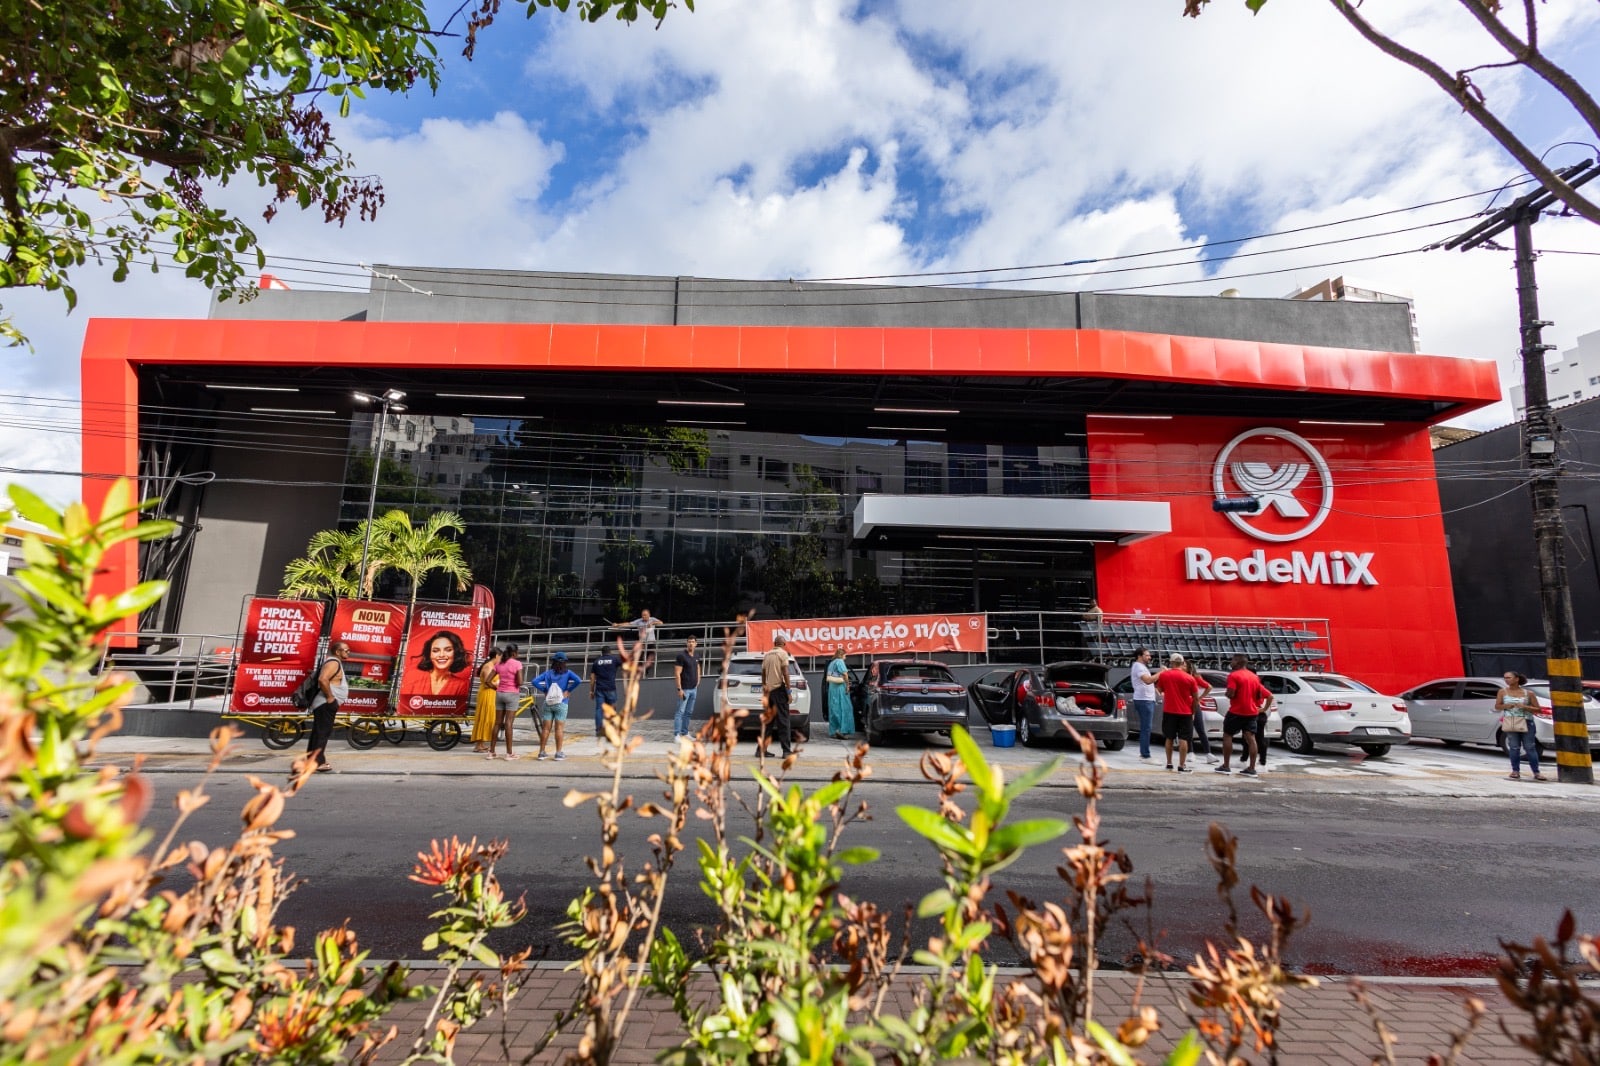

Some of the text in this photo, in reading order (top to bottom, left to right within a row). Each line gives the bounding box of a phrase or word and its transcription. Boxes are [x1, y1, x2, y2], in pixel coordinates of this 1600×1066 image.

[1184, 546, 1379, 585] RedeMiX
[261, 607, 305, 621] PIPOCA,
[358, 611, 386, 623] NOVA
[421, 611, 471, 621] CHAME-CHAME
[258, 618, 315, 633] CHICLETE,
[352, 623, 386, 634] REDEMIX
[772, 621, 909, 643] INAUGURAÇÃO
[257, 630, 302, 643] TOMATE
[341, 632, 392, 645] SABINO SILVA
[253, 642, 300, 654] E PEIXE.
